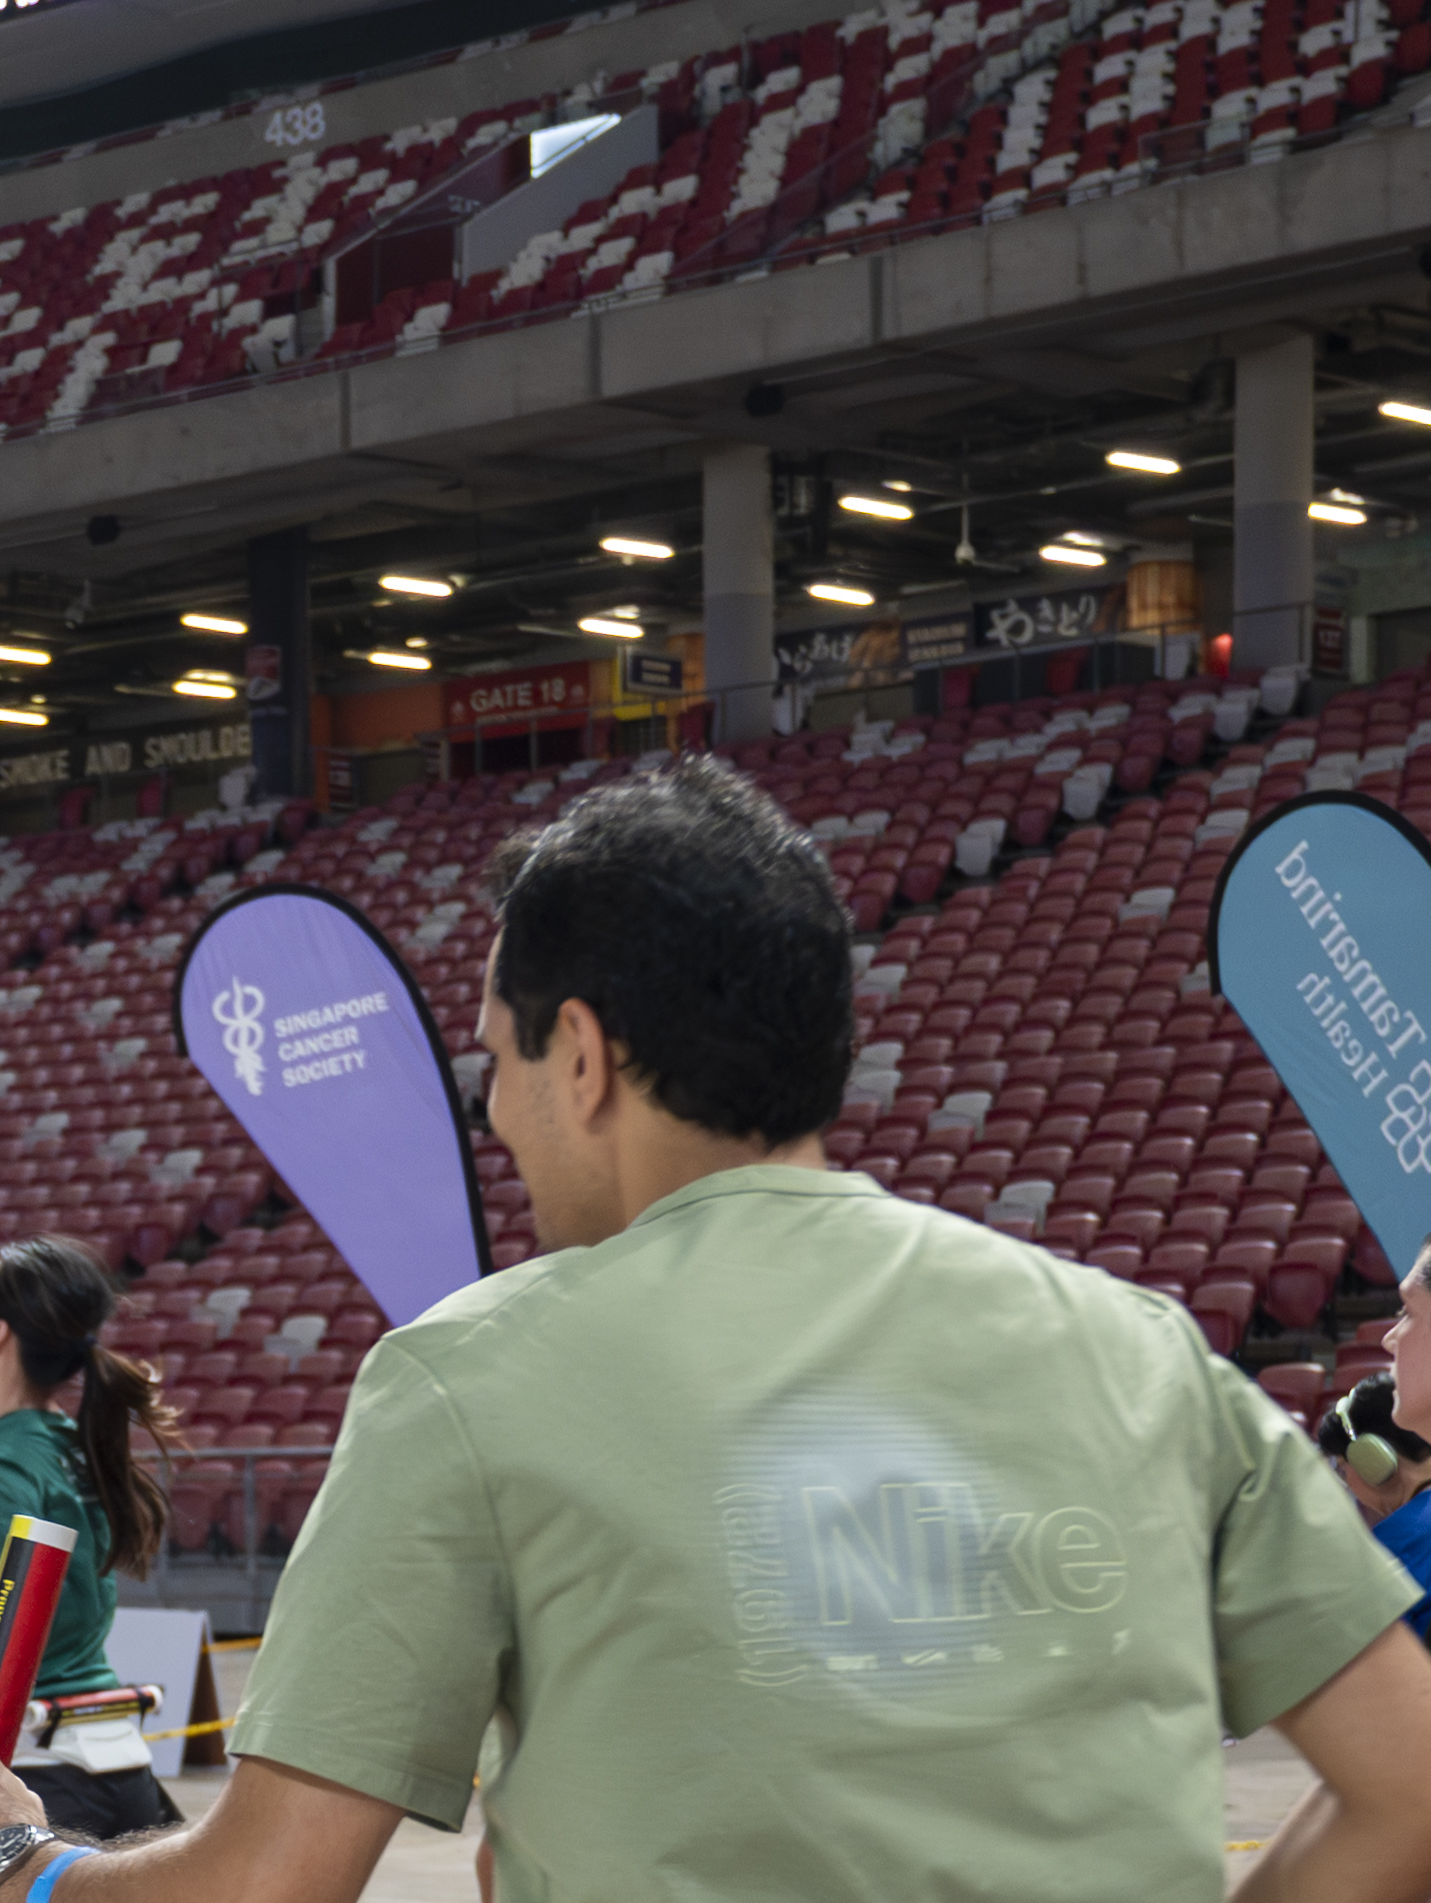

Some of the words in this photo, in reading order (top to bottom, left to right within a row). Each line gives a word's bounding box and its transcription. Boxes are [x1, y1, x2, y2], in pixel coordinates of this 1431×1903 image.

[264, 102, 326, 147] 438
[985, 594, 1097, 648] やきとり
[469, 682, 534, 714] GATE
[541, 677, 567, 703] 18
[85, 741, 132, 776] AND
[142, 725, 253, 769] SMOULDE
[273, 991, 390, 1038] SINGAPORE
[278, 1025, 360, 1062] CANCER
[281, 1049, 367, 1088] SOCIETY
[801, 1482, 1129, 1626] Nike
